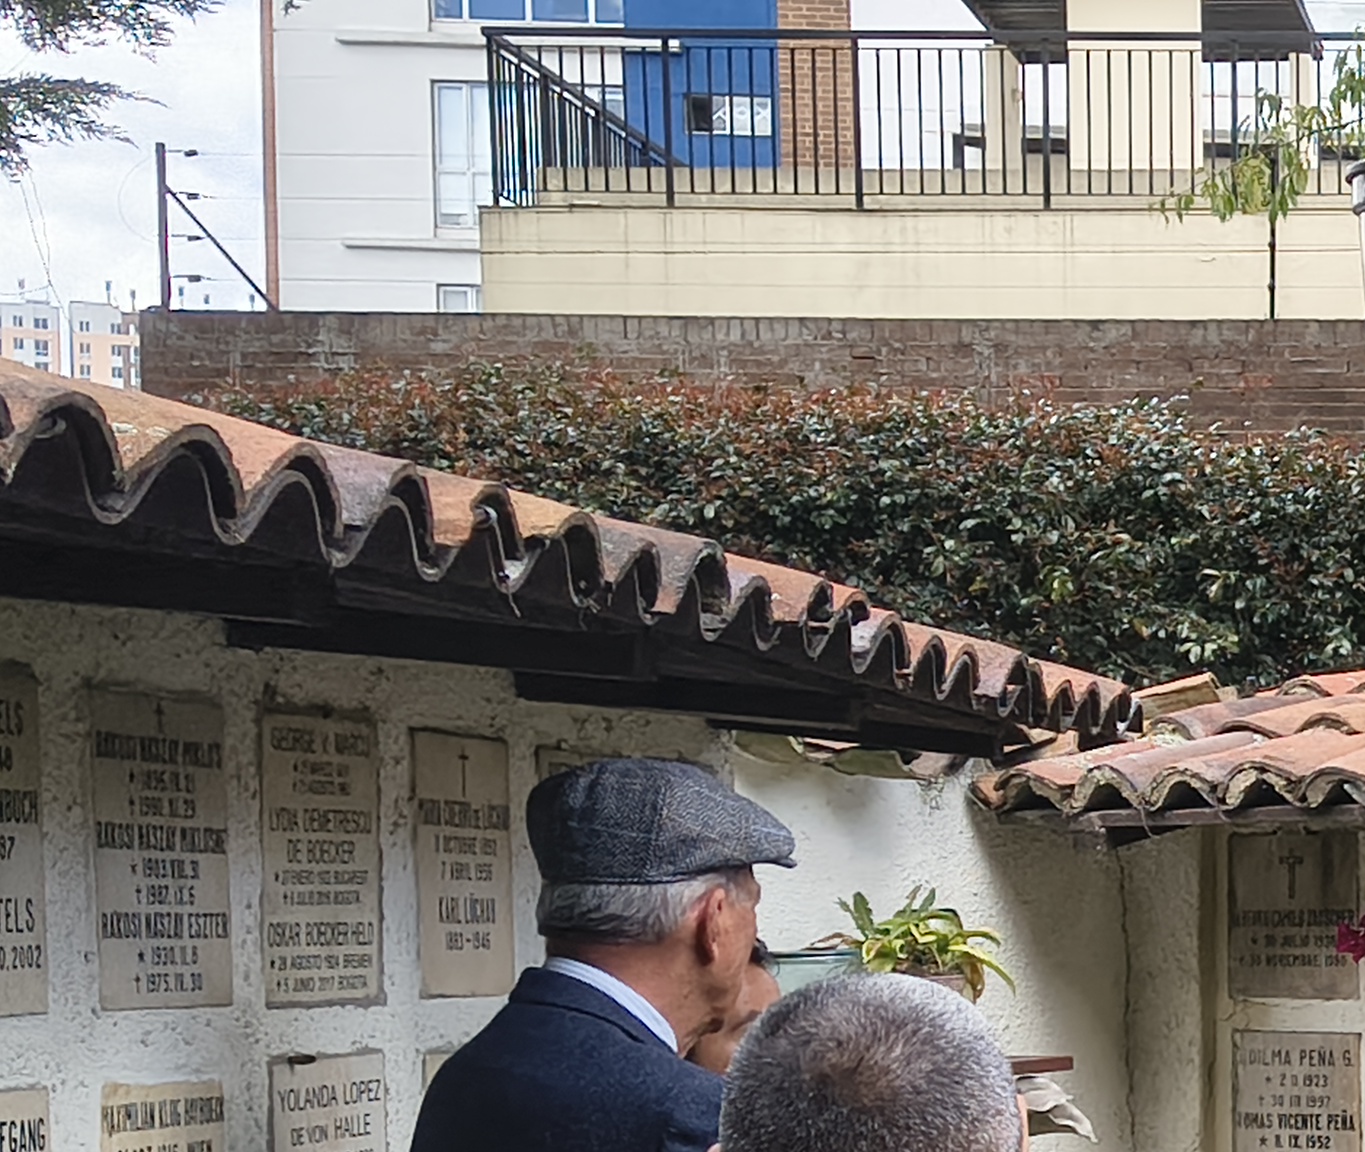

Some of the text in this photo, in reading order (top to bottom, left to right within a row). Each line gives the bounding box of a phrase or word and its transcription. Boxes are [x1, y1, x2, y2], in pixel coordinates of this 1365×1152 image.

[277, 1078, 381, 1113] YOLANDA LOPEZ
[333, 1113, 372, 1140] HALLE
